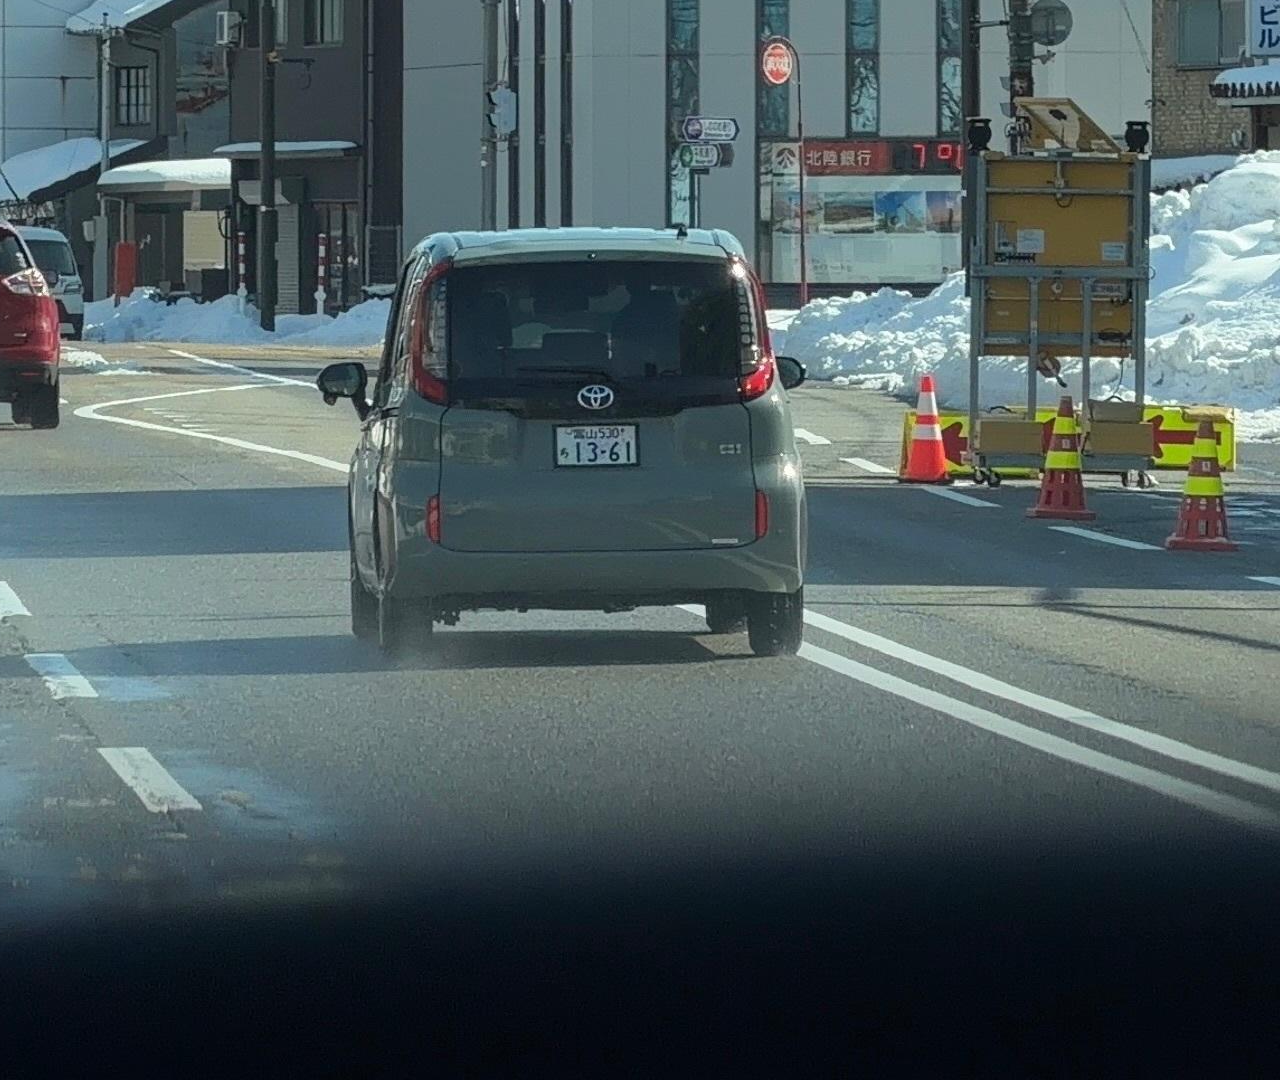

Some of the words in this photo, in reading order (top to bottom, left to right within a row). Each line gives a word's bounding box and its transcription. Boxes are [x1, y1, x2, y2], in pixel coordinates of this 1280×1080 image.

[806, 149, 872, 166] 北陸銀行
[576, 441, 631, 463] 13-61
